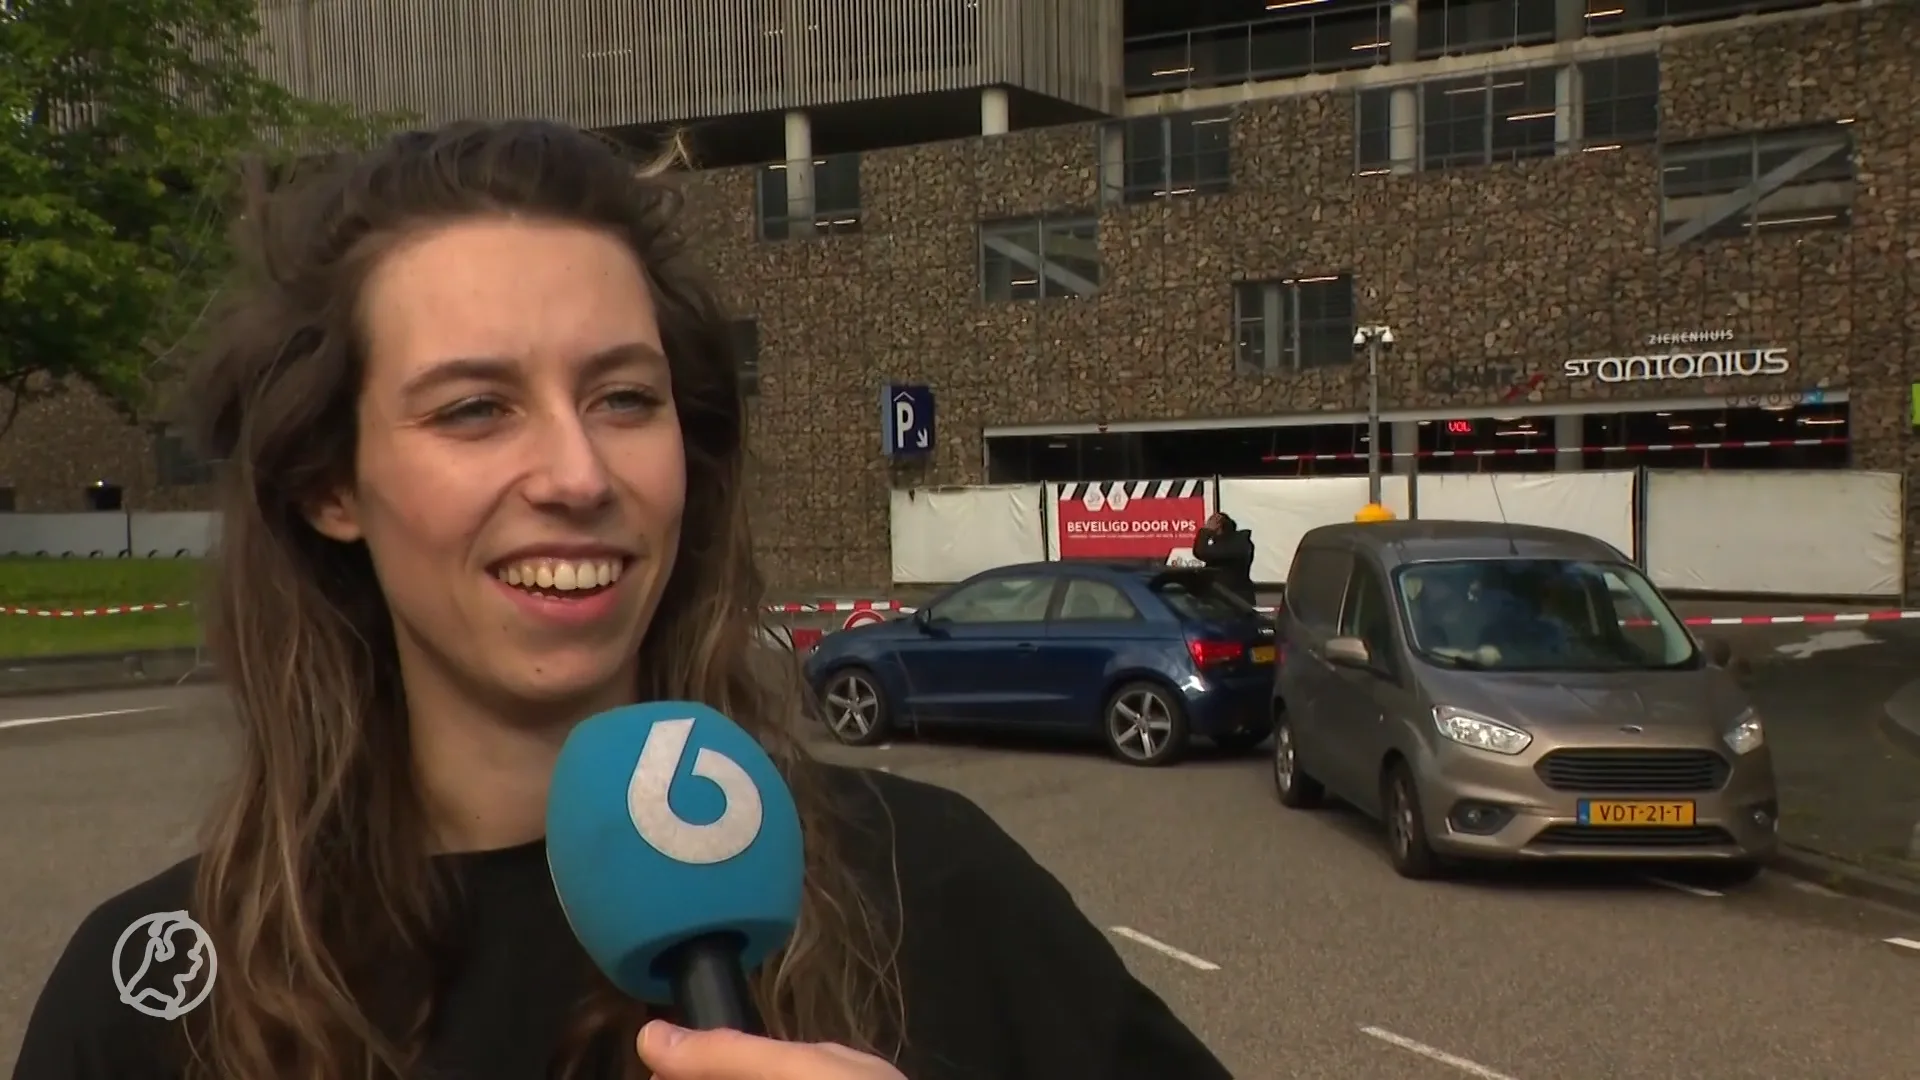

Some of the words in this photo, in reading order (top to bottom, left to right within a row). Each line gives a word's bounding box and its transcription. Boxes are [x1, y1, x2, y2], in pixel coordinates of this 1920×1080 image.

[1648, 329, 1734, 345] ZIEKENHUIS
[896, 401, 914, 449] P
[1448, 421, 1471, 432] VOL
[1067, 521, 1129, 532] BEVEILIGD
[1132, 521, 1169, 532] DOOR
[1171, 520, 1197, 531] VPS
[627, 717, 764, 865] 6
[1599, 804, 1684, 822] VDT-21-T
